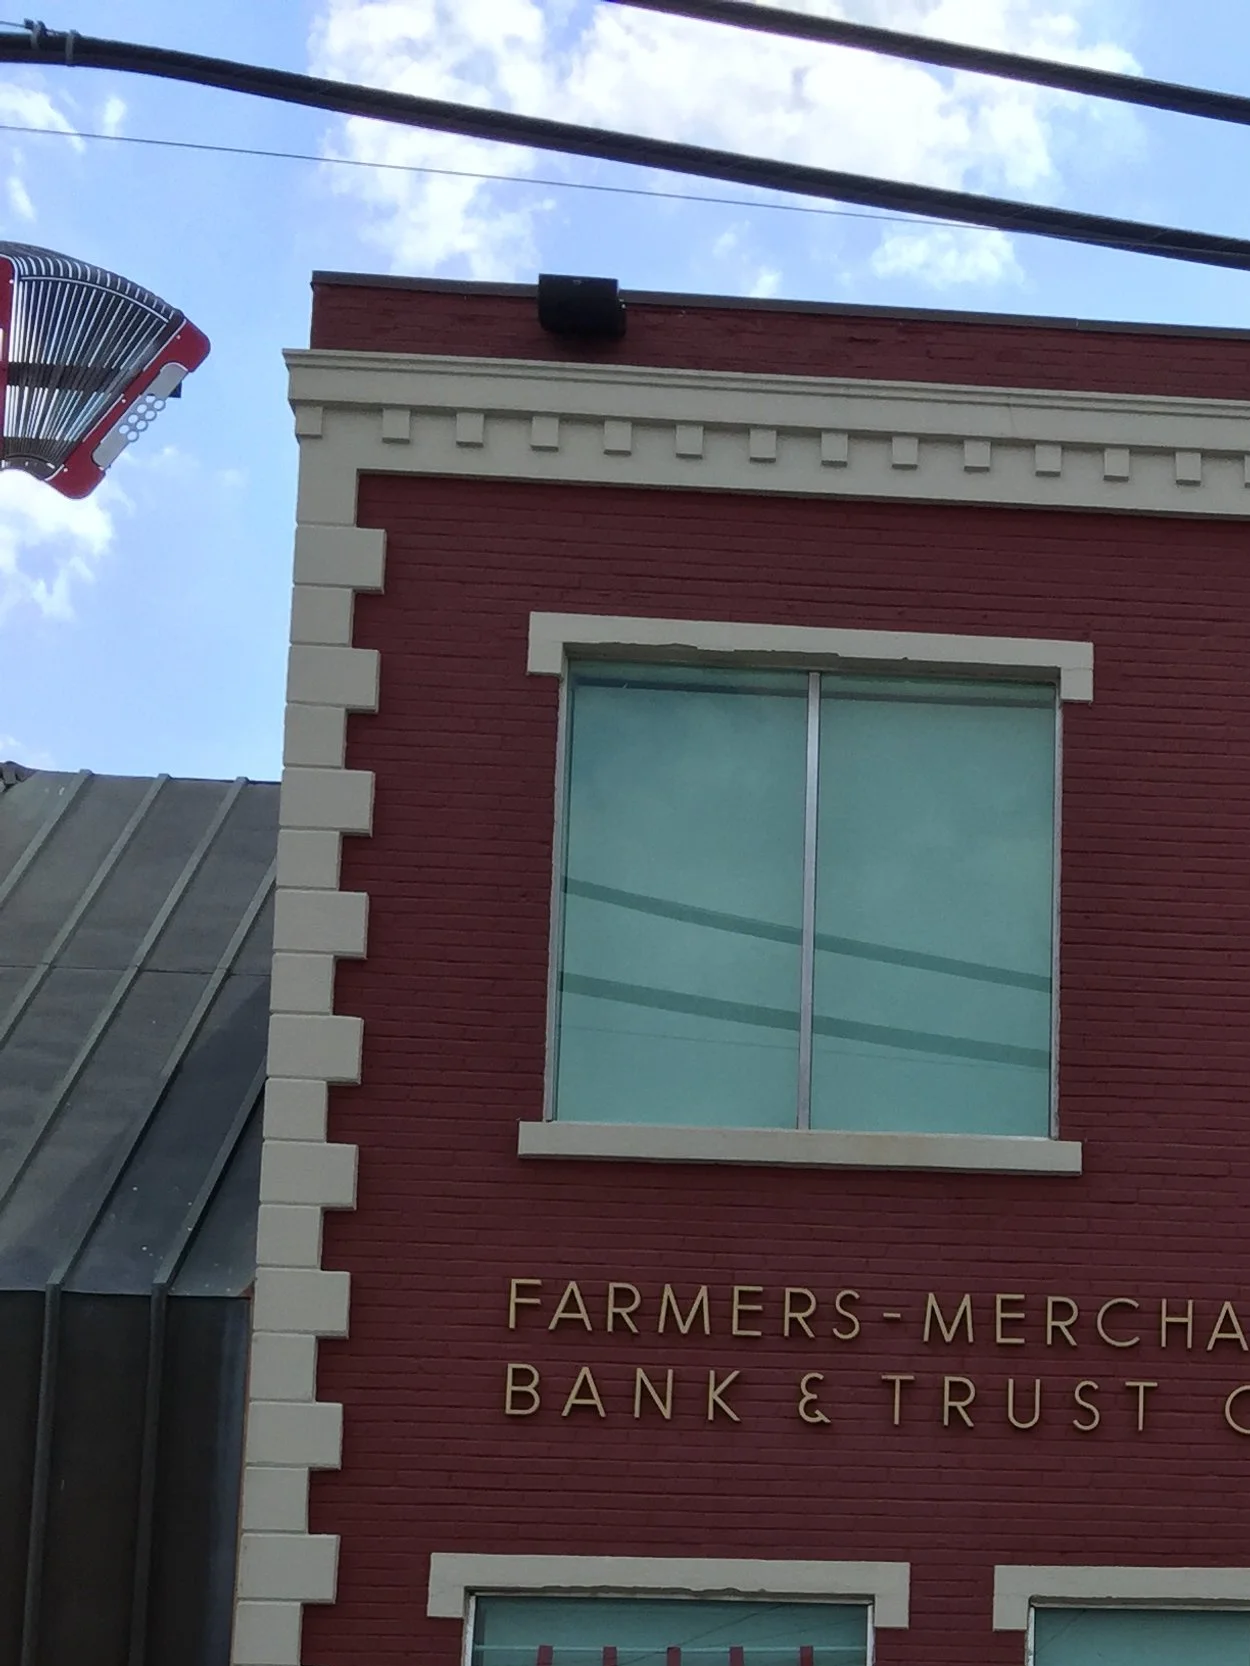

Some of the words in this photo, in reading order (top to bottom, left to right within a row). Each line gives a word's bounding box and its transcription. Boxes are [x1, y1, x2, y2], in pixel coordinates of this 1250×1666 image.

[503, 1362, 742, 1424] BANK
[798, 1372, 833, 1424] &
[881, 1374, 1159, 1433] TRUST
